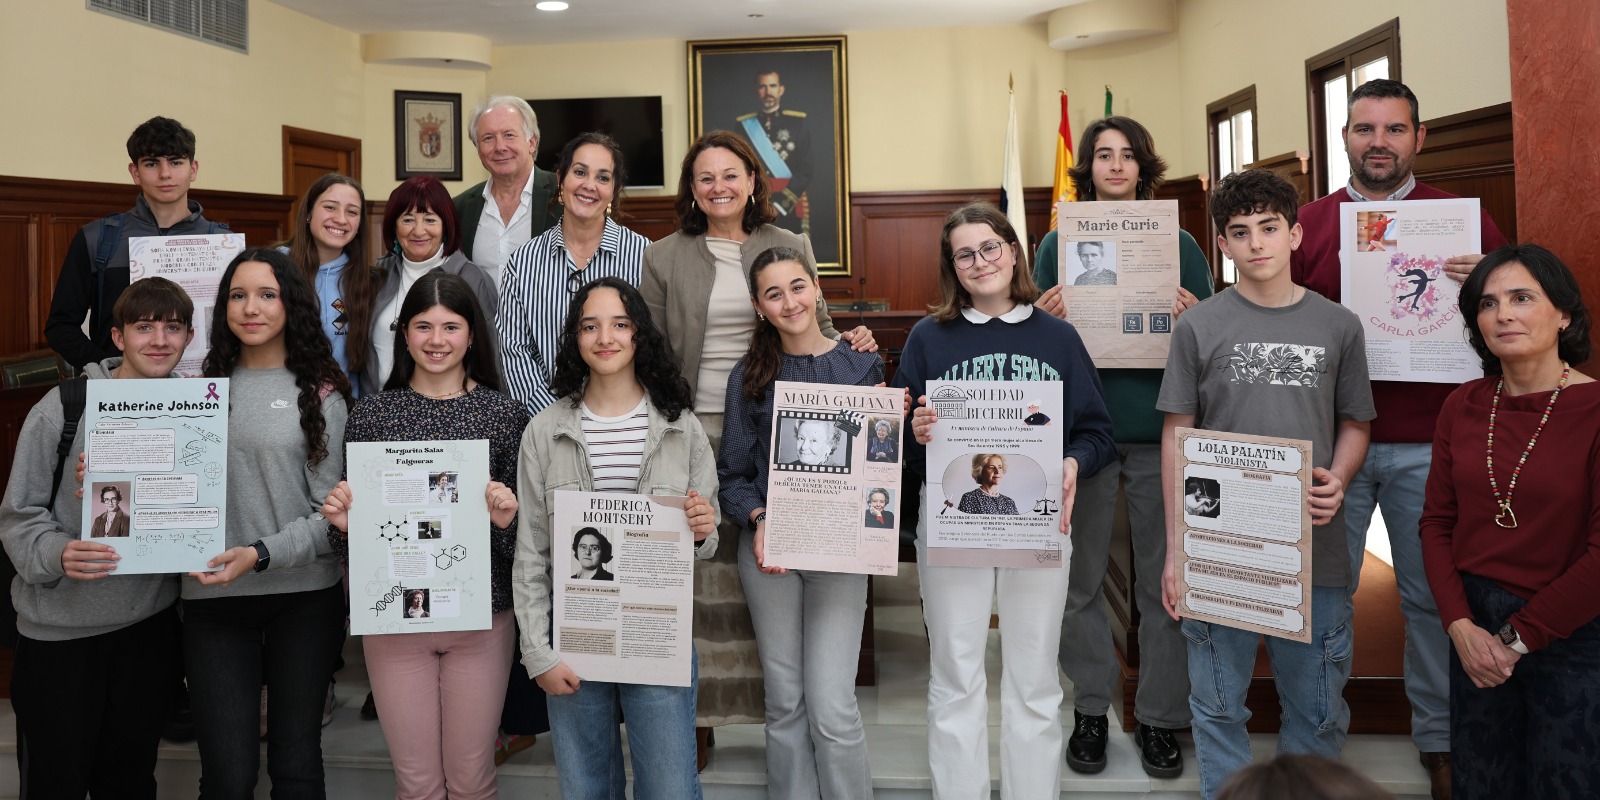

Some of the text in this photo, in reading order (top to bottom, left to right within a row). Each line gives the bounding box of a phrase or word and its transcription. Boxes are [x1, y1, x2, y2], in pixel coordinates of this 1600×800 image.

[1077, 218, 1158, 231] Marie Curie
[1370, 316, 1414, 336] CARLA
[936, 353, 1007, 381] LLERY
[783, 390, 894, 409] MARÍA GALIANA
[966, 389, 1024, 400] SOLEDAD
[98, 400, 219, 412] Katherine Johnson
[968, 408, 1024, 420] BECERRIL
[1198, 442, 1286, 461] LOLA PALATÍN
[1214, 456, 1268, 469] VIOLINISTA
[590, 499, 652, 512] FEDERICA
[583, 512, 654, 525] MONTSENY
[1237, 541, 1263, 549] SOCIEDAD
[1228, 568, 1260, 578] IMPORTANTE
[1261, 575, 1293, 585] VISIBILIZAR
[1234, 574, 1254, 583] ESPACIO
[1191, 592, 1225, 604] BIBLIOGRAFÍA
